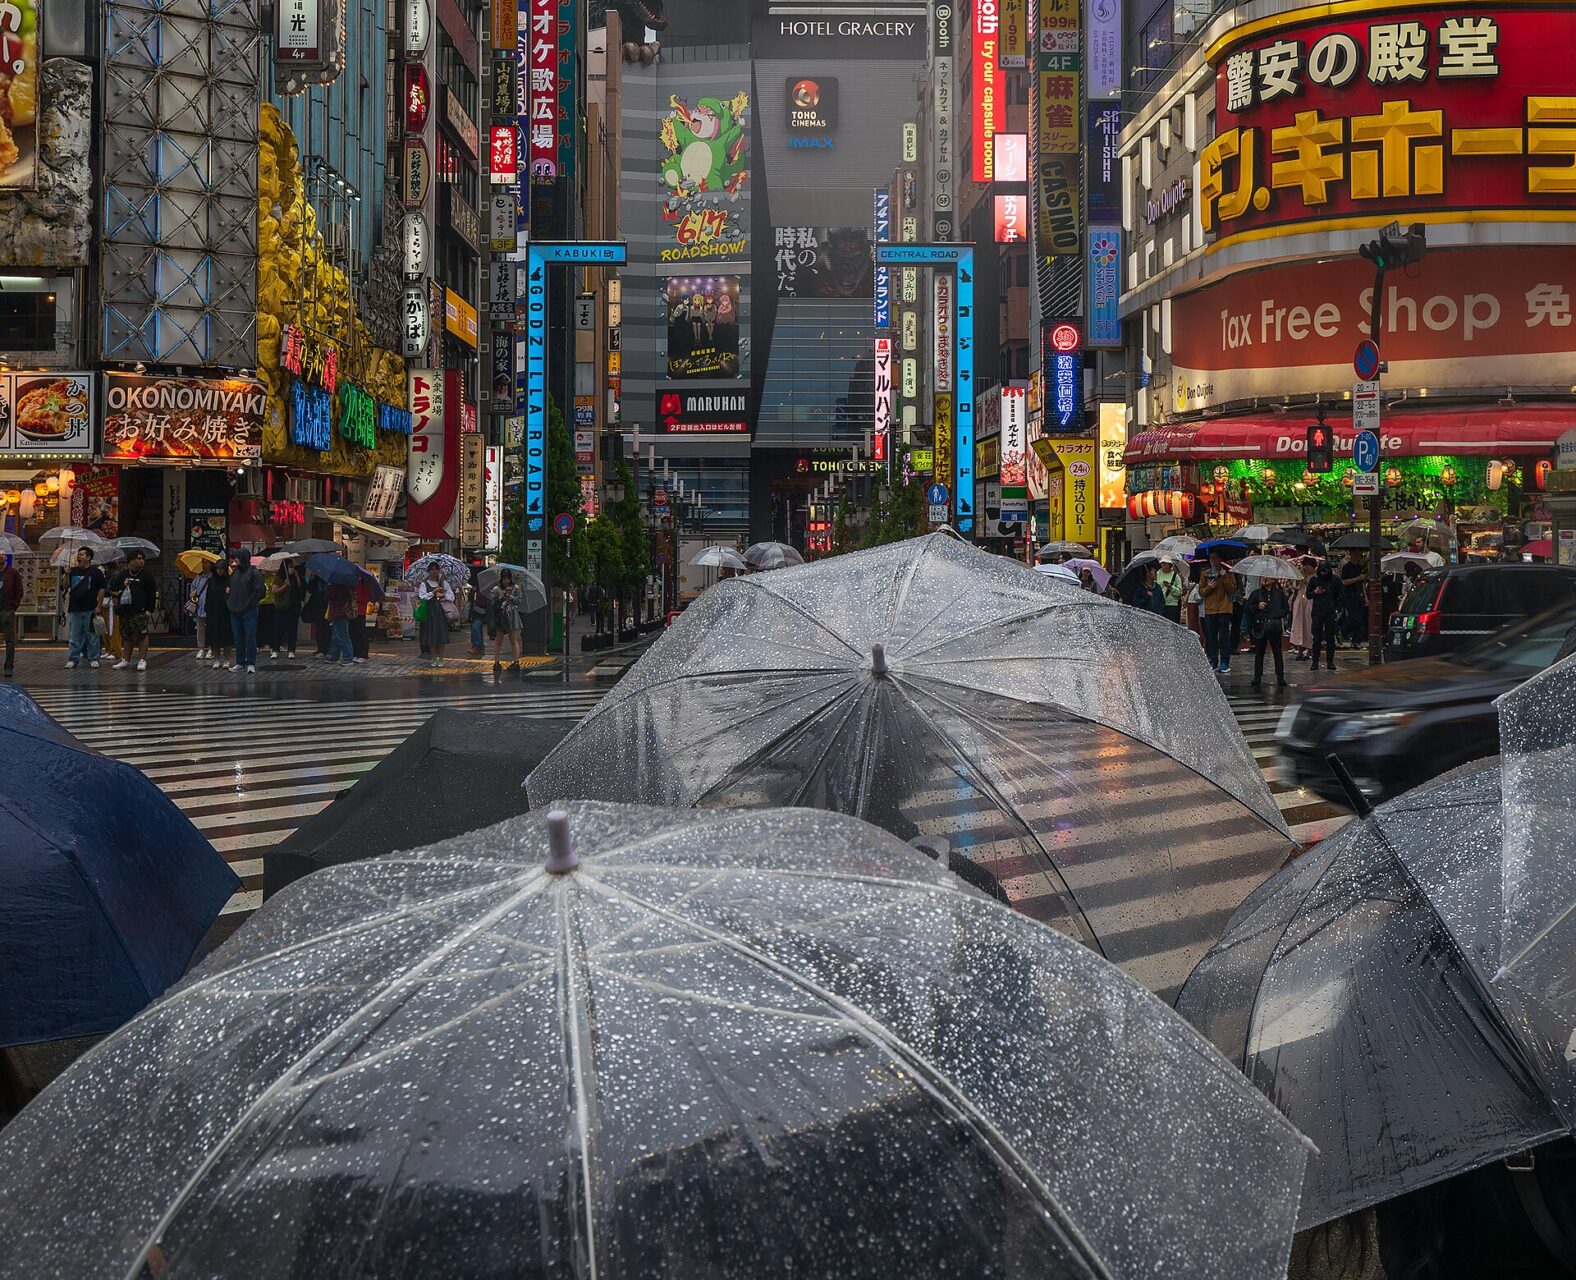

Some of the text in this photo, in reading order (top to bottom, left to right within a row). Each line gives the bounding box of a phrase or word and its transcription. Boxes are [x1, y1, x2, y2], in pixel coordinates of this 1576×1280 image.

[291, 14, 306, 31] 光
[780, 22, 915, 35] HOTEL GRACERY
[936, 5, 950, 48] Booth
[1043, 17, 1076, 28] 199円
[292, 48, 305, 59] 4F
[1048, 56, 1071, 70] 4F
[1226, 17, 1499, 112] 驚安の殿堂
[939, 62, 948, 112] ネットカフェ
[983, 40, 995, 137] try our capsule
[1045, 75, 1074, 129] 麻雀
[791, 111, 817, 120] TOHO
[787, 136, 833, 149] IMAX
[939, 129, 948, 163] カプセル
[1043, 132, 1069, 140] スリー
[1103, 110, 1111, 183] SHISHA
[411, 150, 421, 200] お好み焼き
[1005, 138, 1017, 181] シーシ
[877, 195, 888, 233] 747
[1040, 160, 1078, 248] CASINO
[1147, 178, 1186, 225] Don Quijote
[677, 209, 728, 245] 6/7
[497, 240, 509, 249] 3F
[555, 249, 614, 259] KABUKI町
[661, 239, 746, 261] ROADSHOW!
[797, 227, 818, 274] 私の、
[880, 250, 958, 259] CENTRAL ROAD
[408, 273, 419, 281] 1F
[775, 227, 796, 298] 時代だ。
[1096, 268, 1105, 308] STAGE
[1106, 268, 1115, 300] IDOL
[406, 300, 422, 339] かっぱ
[938, 287, 949, 326] カラオケ
[1221, 286, 1501, 351] Tax Free Shop
[1524, 283, 1573, 328] 免
[407, 343, 420, 351] B1
[108, 387, 267, 415] OKONOMIYAKI
[432, 371, 443, 416] 大衆酒場
[529, 285, 543, 491] GODZILLA ROAD
[686, 396, 745, 411] MARUHAN
[876, 354, 890, 433] マルハン
[959, 305, 972, 477] ゴジラロード
[1186, 383, 1214, 400] Don Quijote
[64, 380, 89, 439] かつ丼
[412, 377, 430, 453] トラノコ
[115, 412, 252, 445] お好み焼き
[1008, 424, 1019, 447] 九十九
[1056, 444, 1093, 453] カラオケ
[1359, 440, 1368, 465] P
[1365, 454, 1373, 465] 40
[413, 460, 427, 491] やきとん
[425, 453, 439, 485] やきとり
[1073, 464, 1087, 473] 24H
